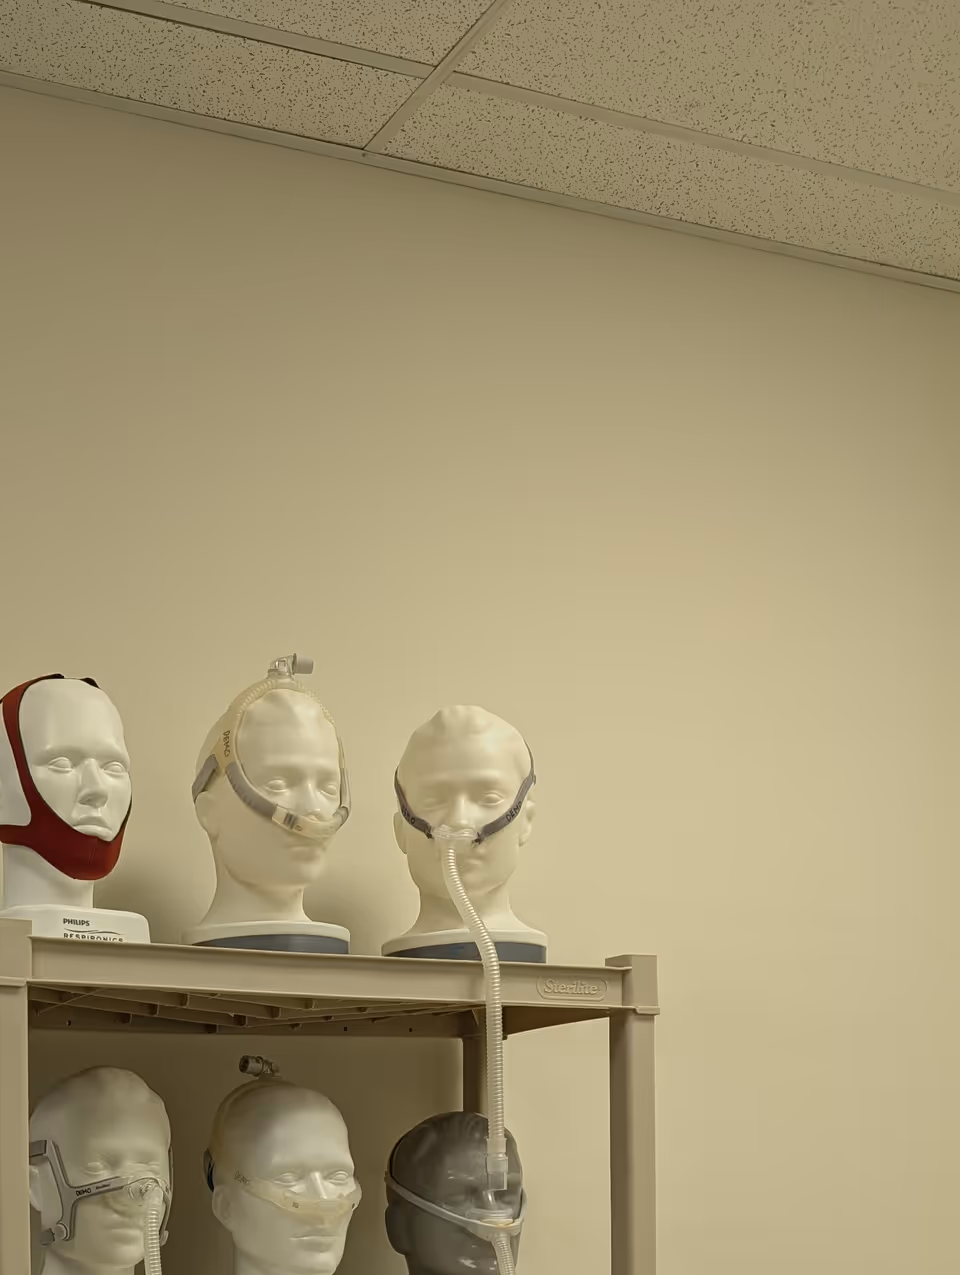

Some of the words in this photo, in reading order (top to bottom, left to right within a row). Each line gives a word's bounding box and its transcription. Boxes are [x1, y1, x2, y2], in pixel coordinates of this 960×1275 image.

[505, 800, 523, 823] DEMO
[62, 917, 91, 927] PHILIPS
[543, 978, 599, 995] Sterilite
